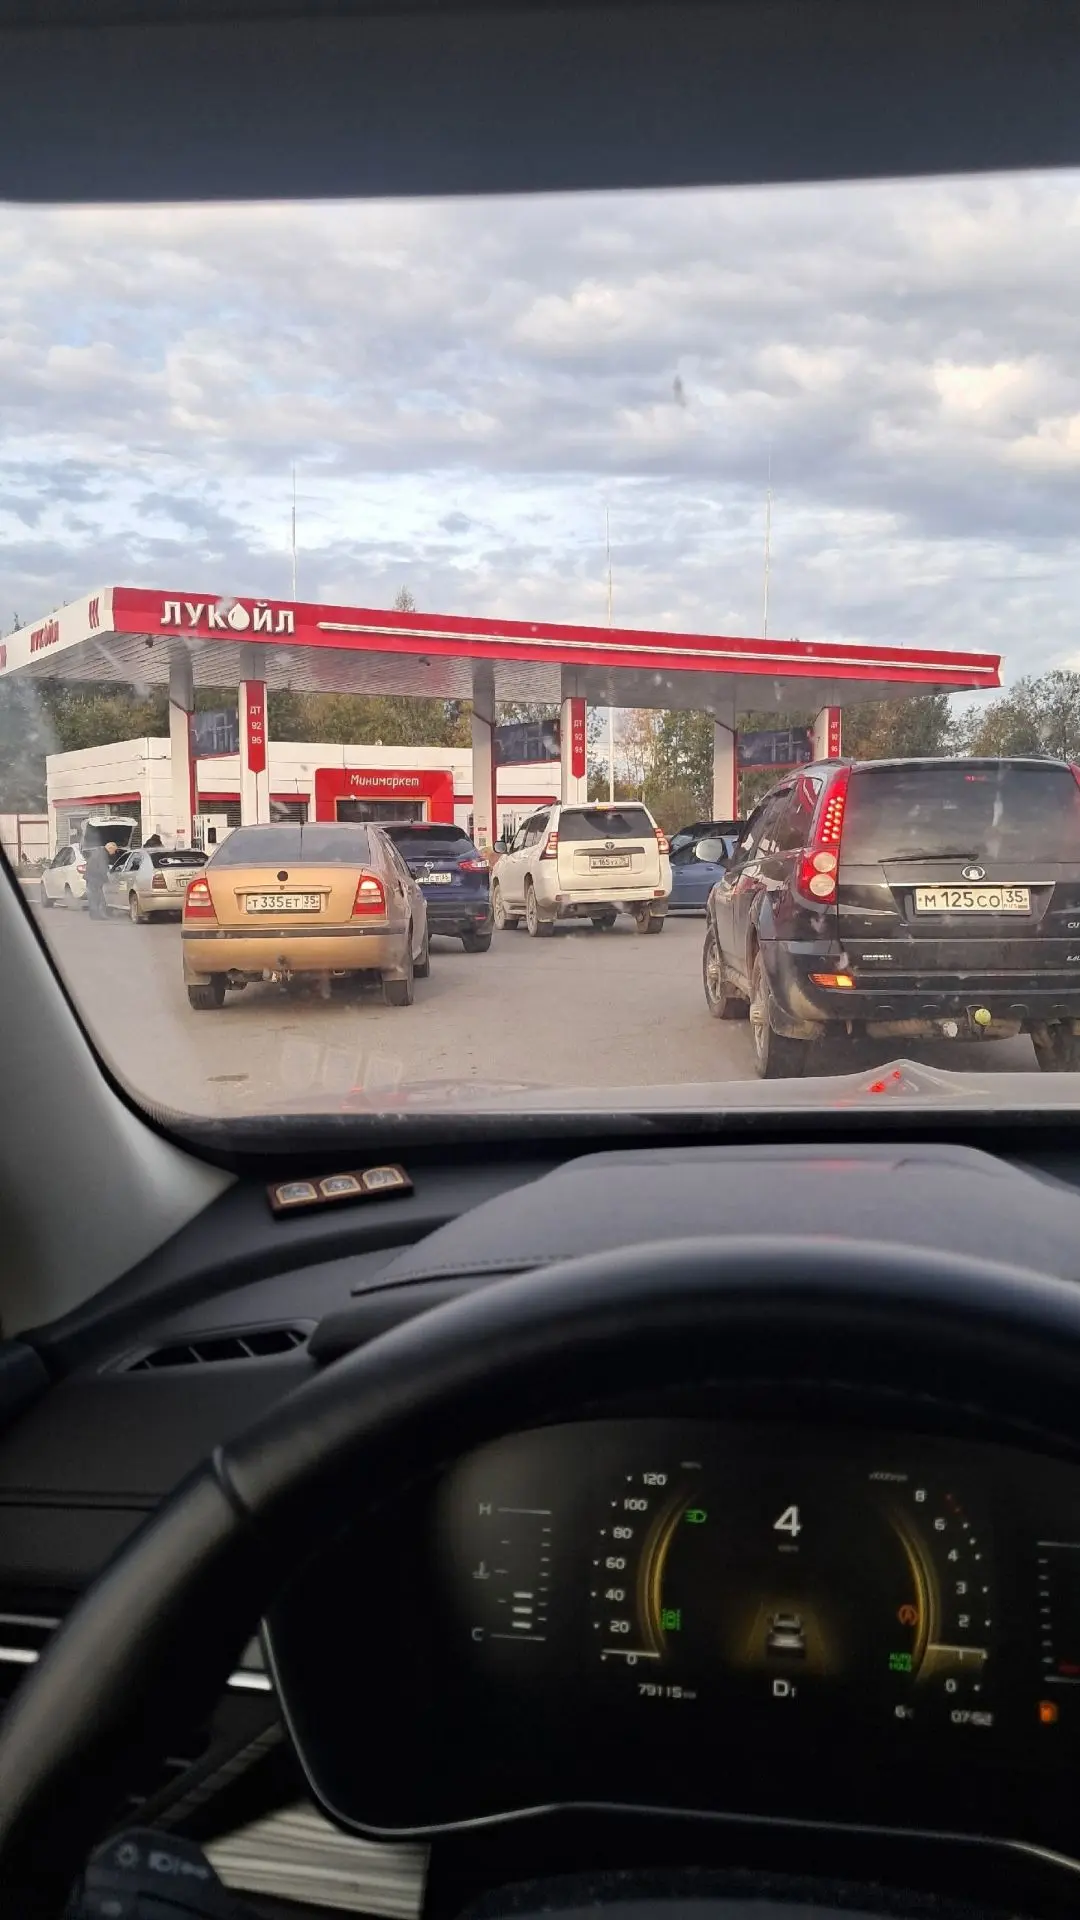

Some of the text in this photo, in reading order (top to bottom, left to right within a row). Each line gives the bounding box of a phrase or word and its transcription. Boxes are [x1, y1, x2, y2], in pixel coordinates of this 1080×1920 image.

[160, 600, 294, 633] ЛУКОЙЛ
[250, 705, 261, 715] ДТ
[251, 722, 262, 730] 92
[350, 774, 419, 789] Минимаркет
[643, 1473, 667, 1486] 120
[479, 1503, 491, 1515] H
[624, 1499, 648, 1511] 100
[772, 1504, 803, 1538] 4
[613, 1527, 632, 1539] 80
[606, 1557, 625, 1570] 60
[956, 1581, 967, 1594] 3
[606, 1589, 625, 1601] 40
[610, 1620, 630, 1633] 20
[958, 1614, 970, 1628] 2
[471, 1627, 484, 1641] C
[945, 1679, 957, 1692] 0
